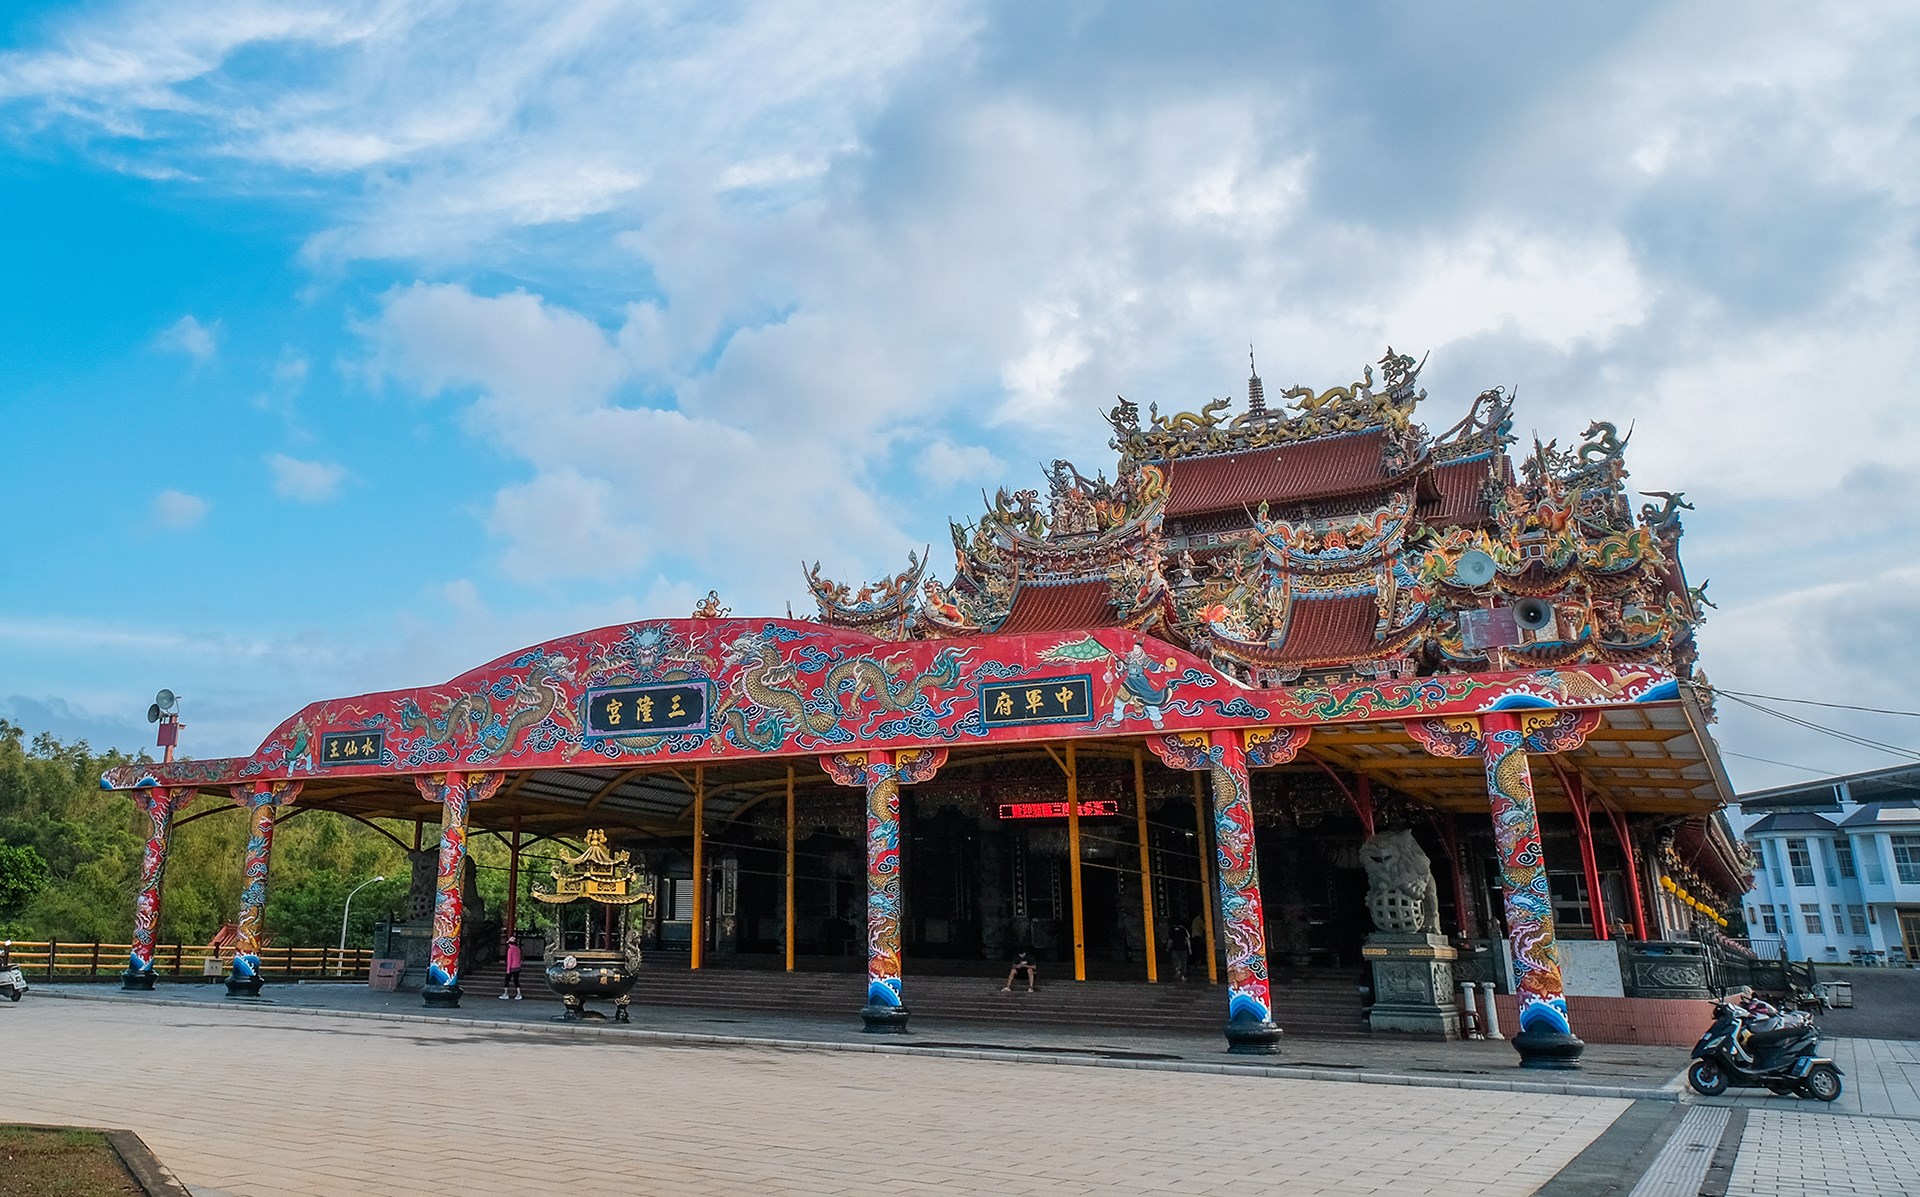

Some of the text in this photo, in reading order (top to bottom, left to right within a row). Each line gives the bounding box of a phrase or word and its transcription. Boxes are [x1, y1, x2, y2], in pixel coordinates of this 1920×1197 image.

[606, 694, 686, 725] 三隆宮
[993, 686, 1074, 716] 中軍府
[329, 736, 376, 758] 水仙王
